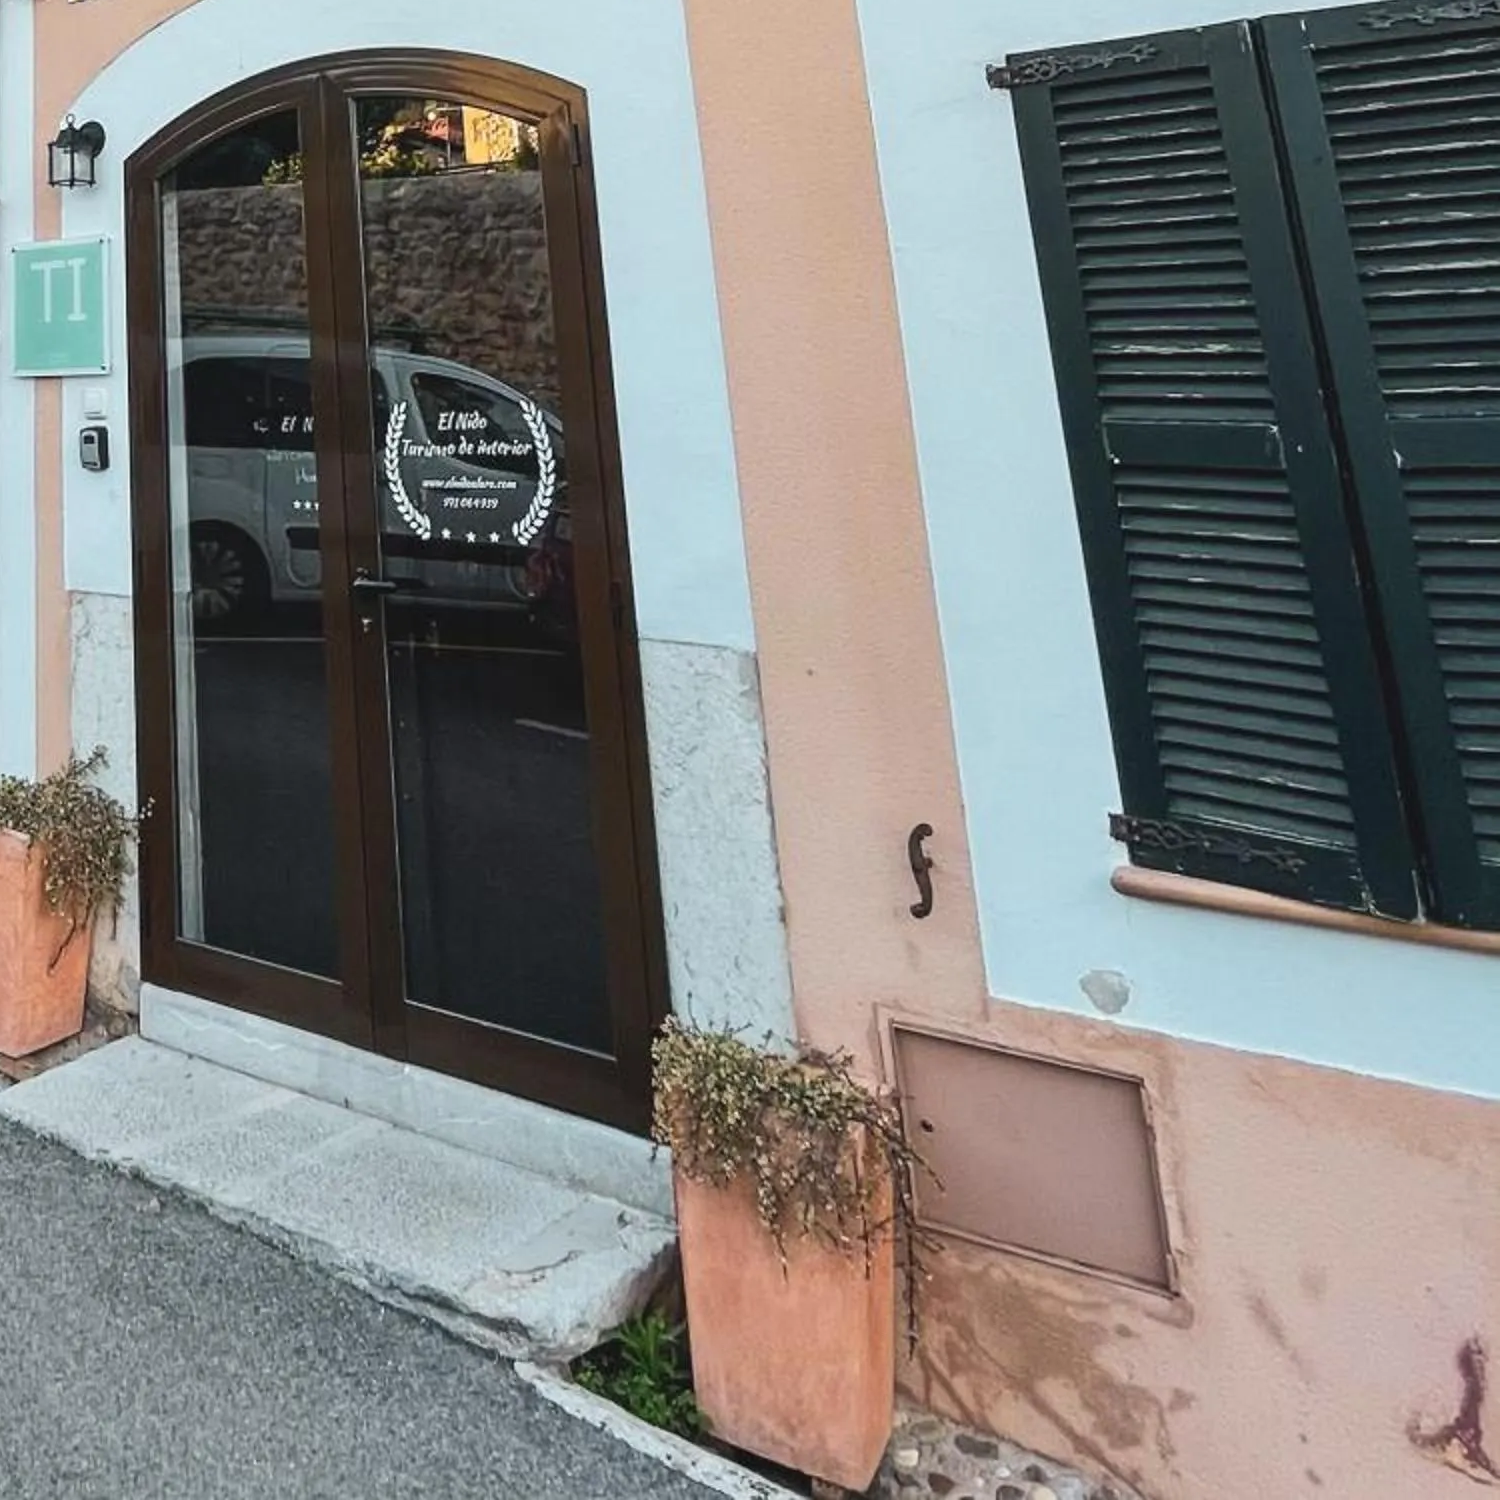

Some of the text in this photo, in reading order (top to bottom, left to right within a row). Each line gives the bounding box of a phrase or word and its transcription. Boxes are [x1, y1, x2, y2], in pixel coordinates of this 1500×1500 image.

[30, 257, 86, 323] TI
[438, 409, 487, 431] El Nido
[402, 435, 533, 457] Turismo de interior
